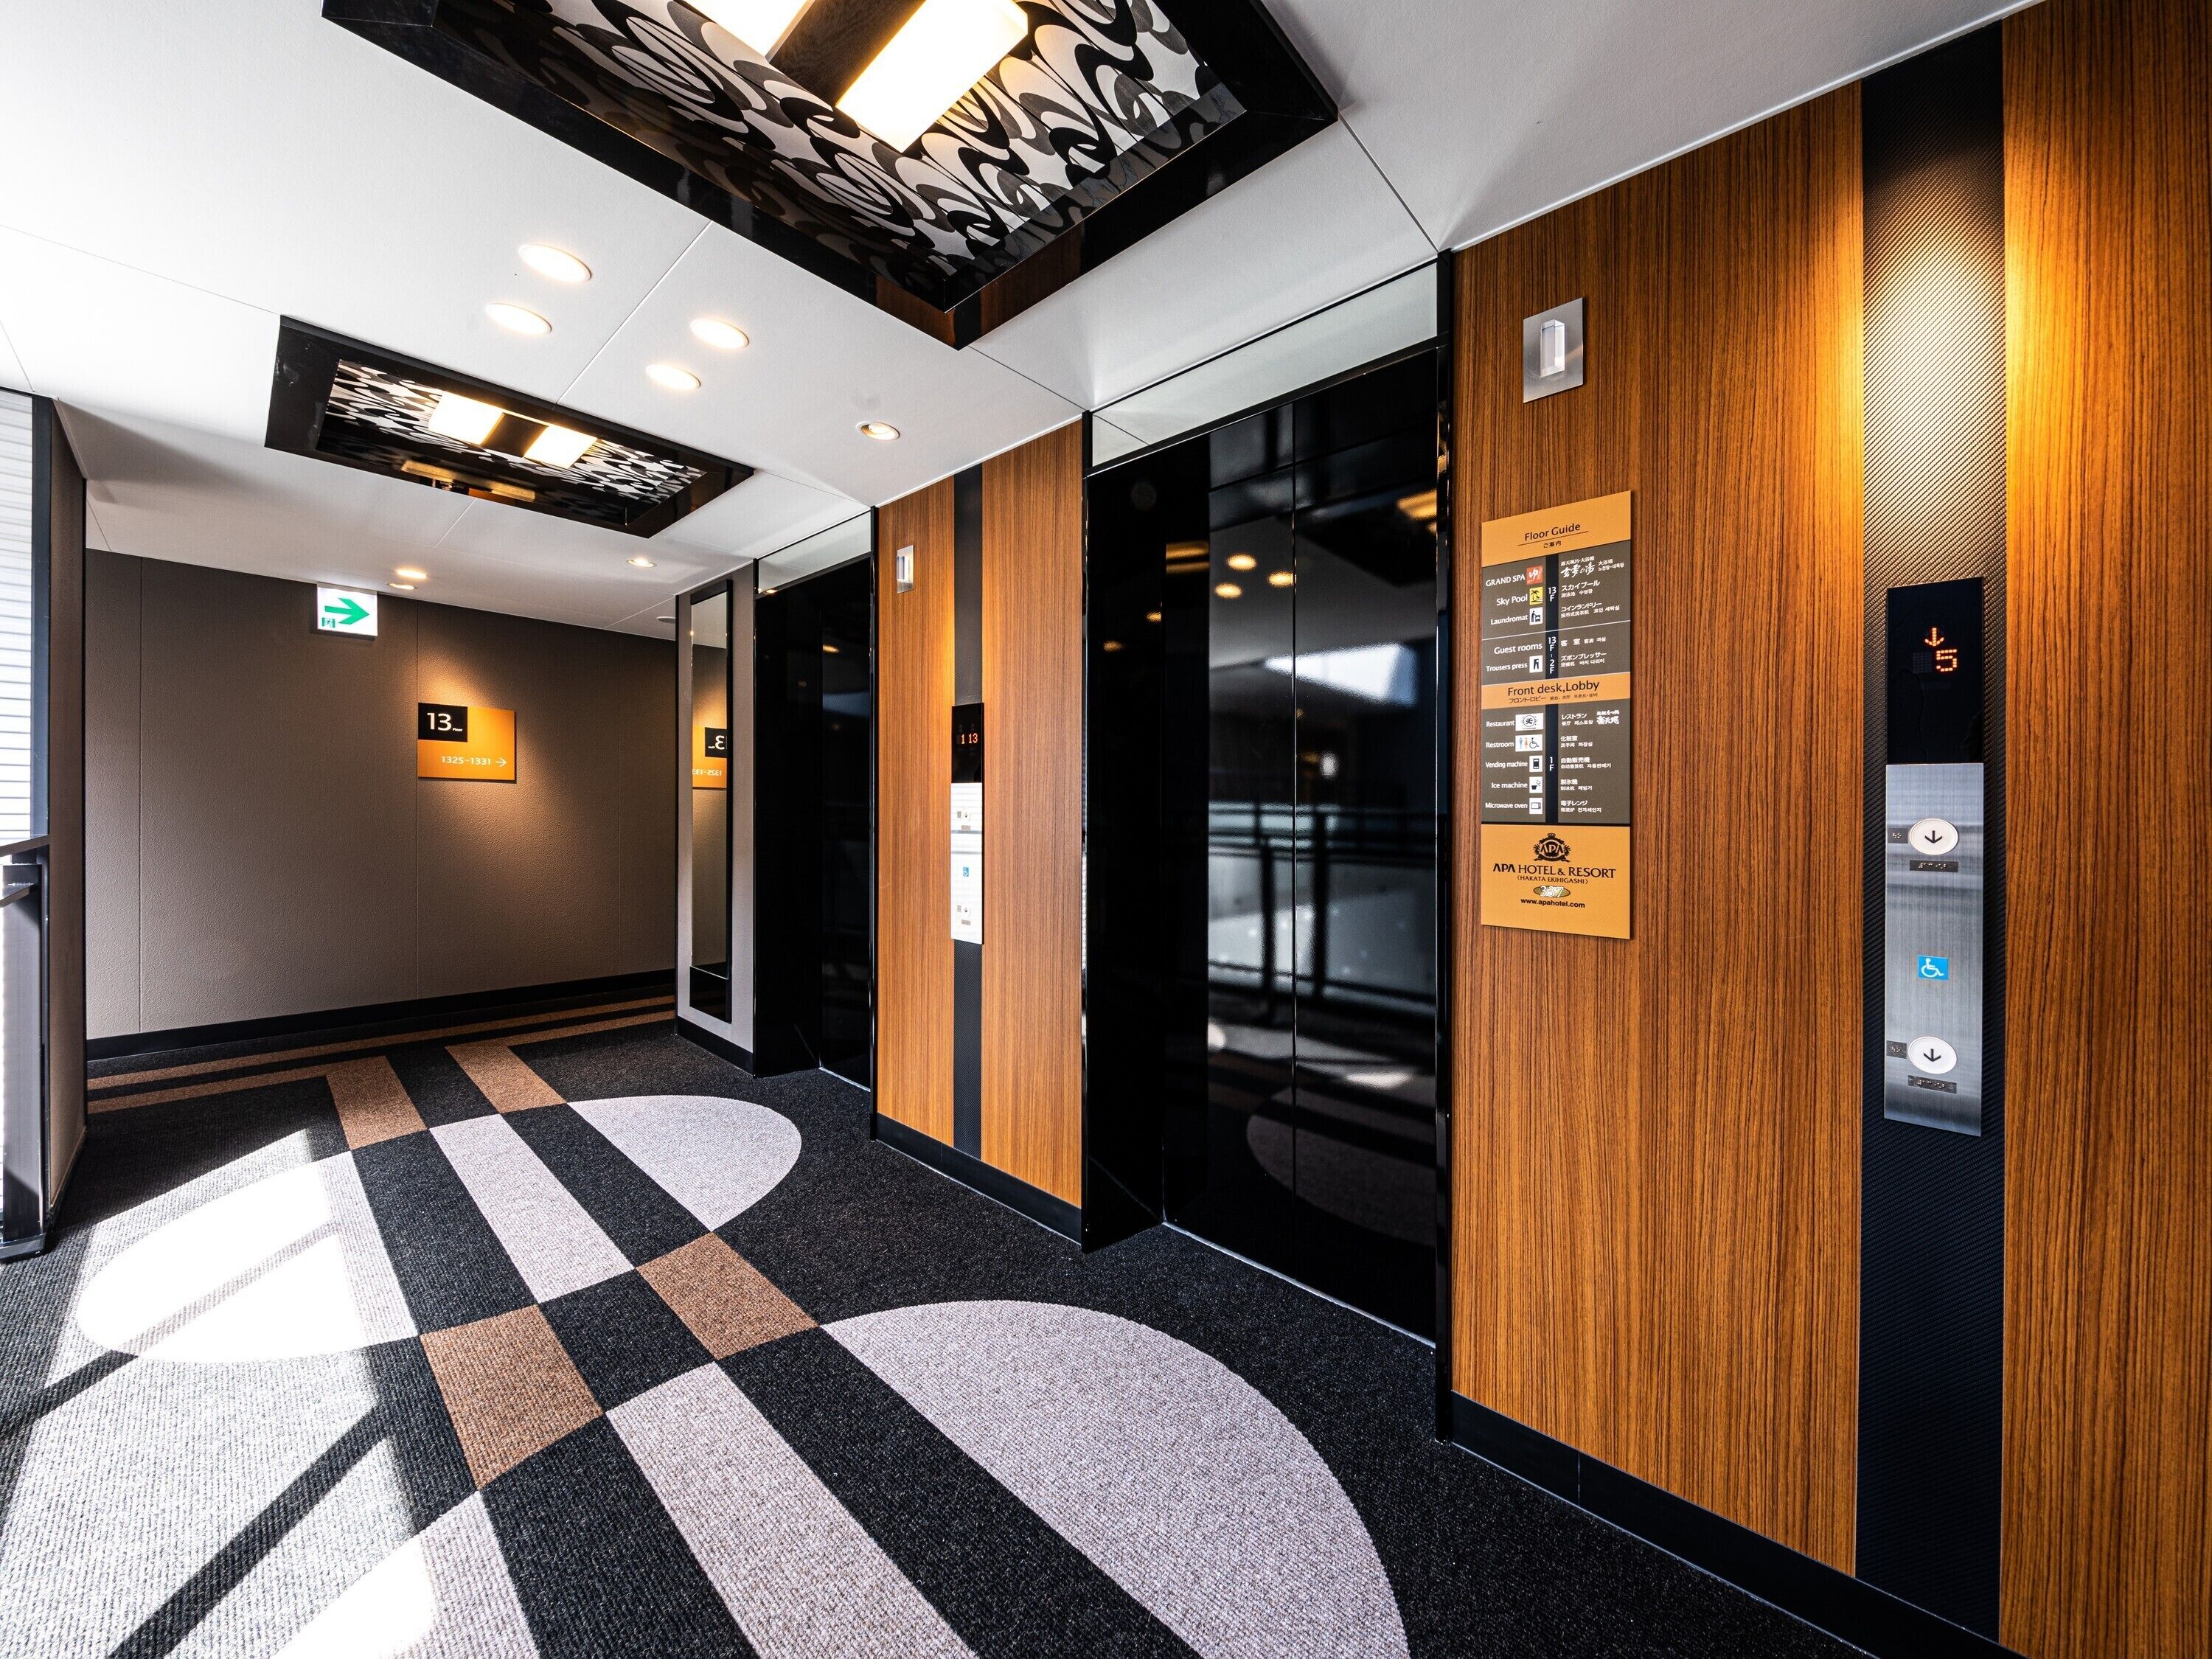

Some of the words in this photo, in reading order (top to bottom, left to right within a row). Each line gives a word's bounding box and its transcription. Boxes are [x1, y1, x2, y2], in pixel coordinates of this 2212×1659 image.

[1525, 529, 1549, 541] Floor
[1551, 524, 1581, 535] Guide
[1486, 577, 1511, 587] GRAND
[1513, 574, 1525, 582] SPA
[1562, 580, 1600, 591] スカイプール
[1497, 597, 1509, 606] Sky
[1512, 594, 1528, 603] Pool
[1562, 602, 1601, 612] コインランドリー
[1491, 614, 1528, 625] Laundromat
[1548, 636, 1557, 644] 13
[1494, 646, 1516, 655] Guest
[1517, 643, 1543, 652] rooms
[1935, 649, 1958, 672] 5
[1486, 664, 1511, 672] Trousers
[1512, 662, 1528, 671] press
[1508, 686, 1534, 696] Front
[427, 712, 451, 731] 13
[961, 734, 965, 745] 1
[969, 733, 978, 743] 13
[1540, 844, 1563, 853] APA
[1493, 863, 1516, 873] APA
[1519, 866, 1556, 874] HOTEL
[1569, 867, 1616, 878] RESORT
[1540, 885, 1564, 898] 337
[1520, 898, 1585, 908] www.apahotel.com
